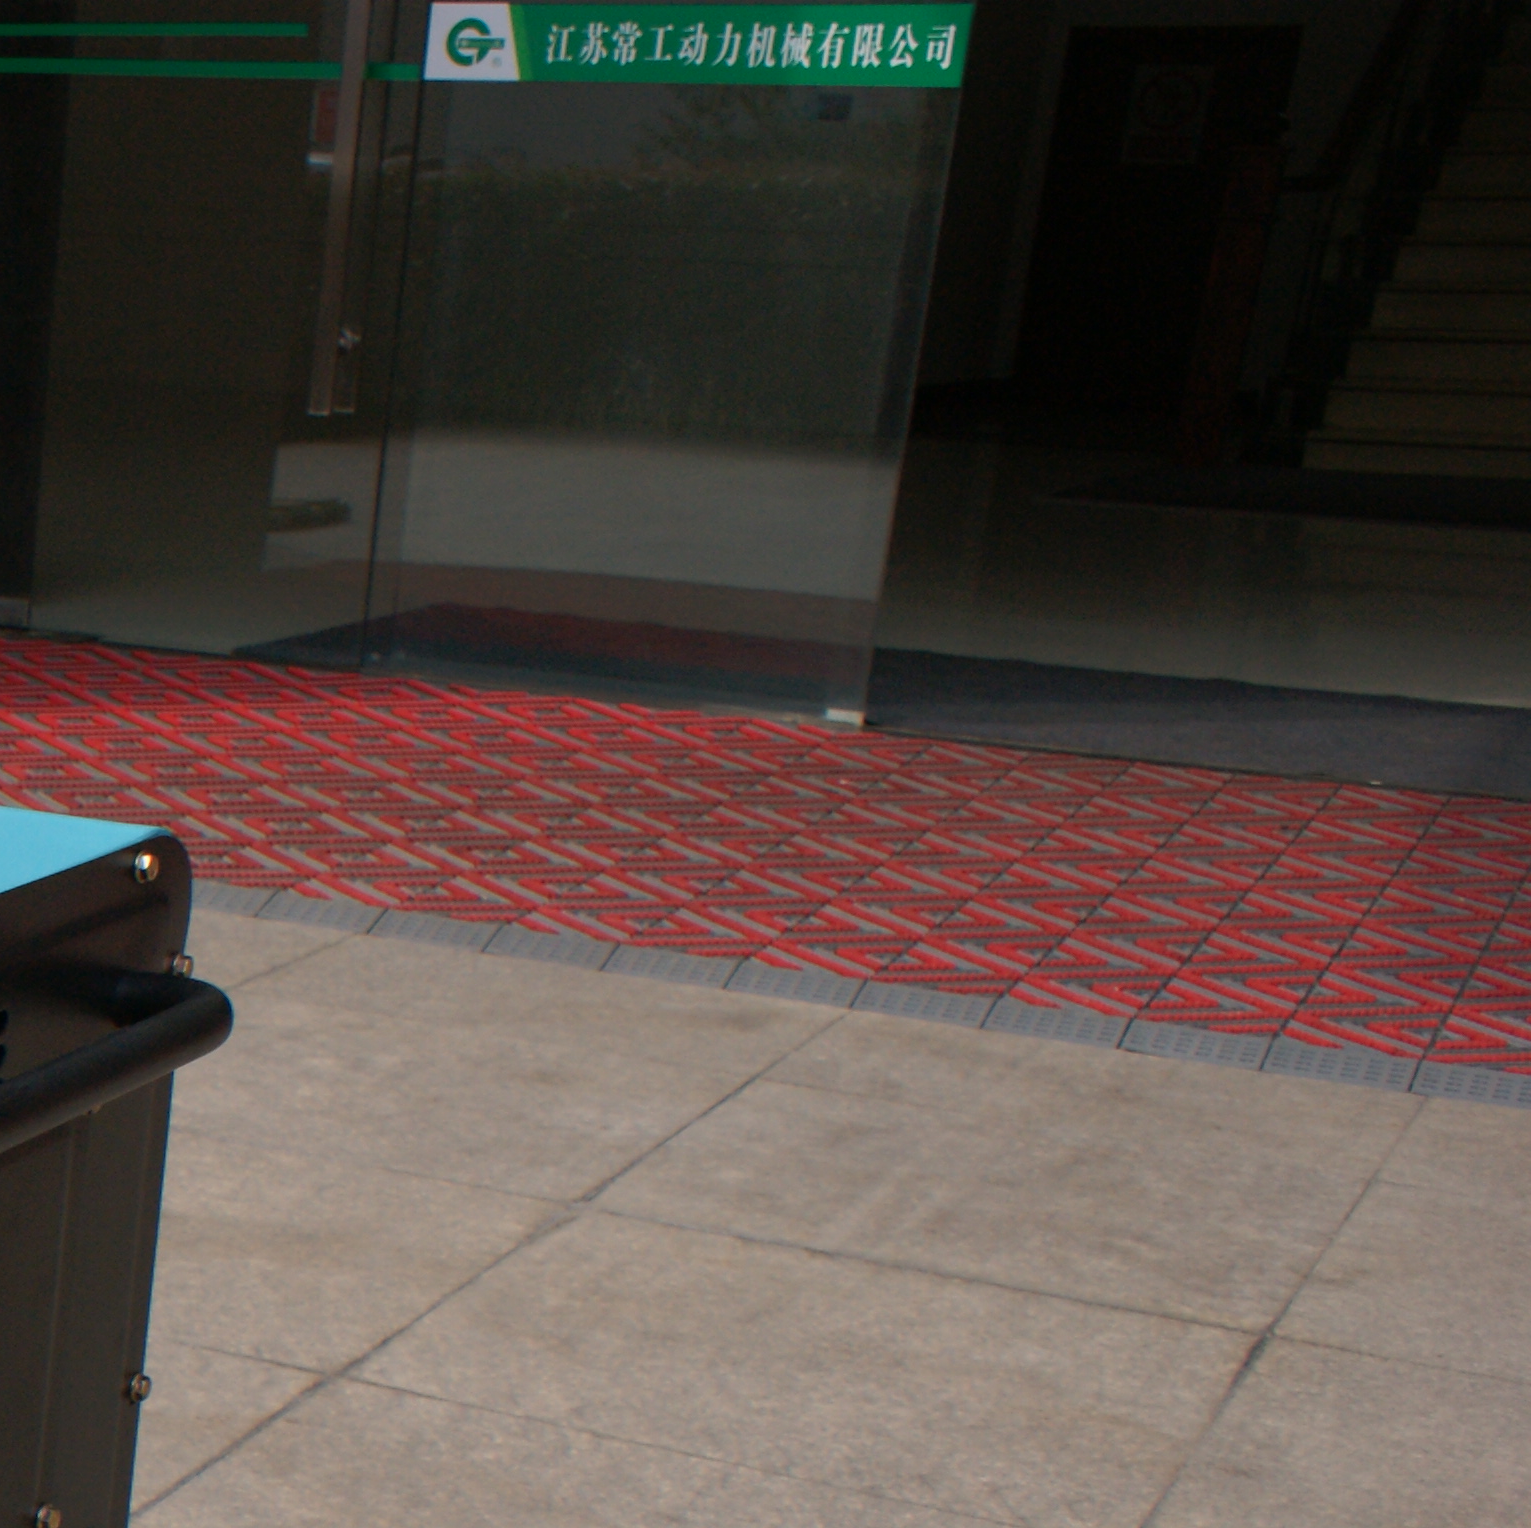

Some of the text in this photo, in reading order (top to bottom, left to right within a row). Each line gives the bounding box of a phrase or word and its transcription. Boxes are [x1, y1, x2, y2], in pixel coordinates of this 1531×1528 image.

[545, 20, 957, 71] 江苏常工动力机械有限公司
